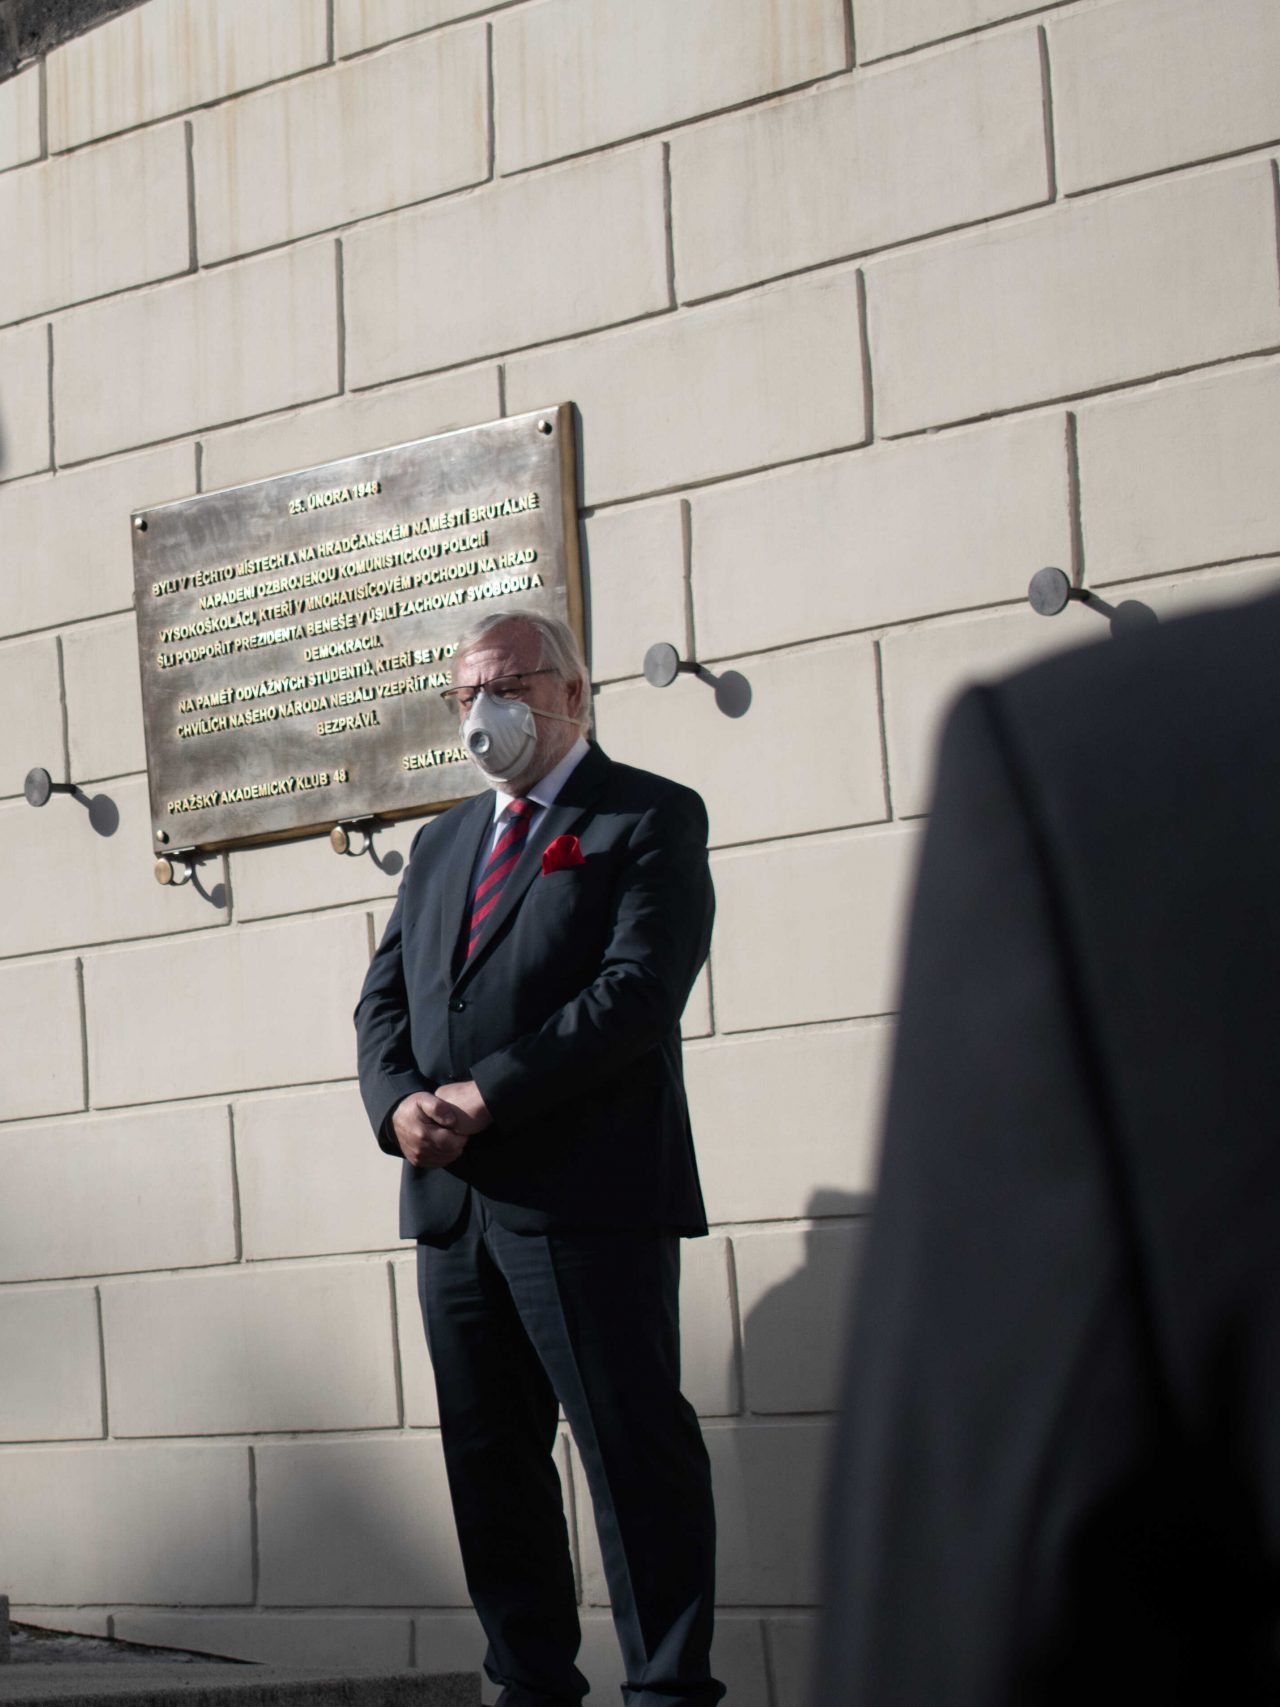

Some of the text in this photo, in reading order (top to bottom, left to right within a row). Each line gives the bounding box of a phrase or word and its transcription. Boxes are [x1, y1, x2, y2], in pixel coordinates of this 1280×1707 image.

[289, 482, 378, 513] 25. ÚNORA 1948
[152, 493, 536, 596] BYLI V TĚCHTO MÍSTECH A NA HRADČANSKÉM NÁMĚSTÍ BRUTÁLNĚ
[199, 532, 485, 608] NAPADENI OZBROJENOU KOMUNISTICKOU POLICIÍ
[157, 574, 541, 667] ŠLI PODPOŘIT PREZIDENTA BENEŠE V ÚSILÍ ZACHOVAT SVOBODU A
[160, 550, 533, 642] VYSOKOŠKOLÁCI, KTEŘÍ V MNOHATISÍCOVÉM POCHODU NA HRAD
[304, 636, 380, 660] DEMOKRACII.
[177, 716, 226, 737] CHVÍLÍCH
[230, 707, 275, 726] NAŠEHO
[279, 696, 328, 717] NÁRODA
[331, 686, 373, 706] NEBÁLI
[377, 676, 425, 697] VZEPŘÍT
[179, 699, 193, 712] NA
[197, 689, 234, 708] PAMĚŤ
[236, 674, 305, 700] ODVÁŽNÝCH
[309, 660, 375, 686] STUDENTŮ,
[376, 652, 411, 671] KTEŘÍ
[414, 649, 431, 663] SE
[433, 648, 441, 659] V
[317, 710, 377, 734] BEZPRÁVÍ.
[403, 749, 442, 769] SENÁT
[168, 770, 346, 812] PRAŽSKÝ AKADEMICKÝ KLUB 48
